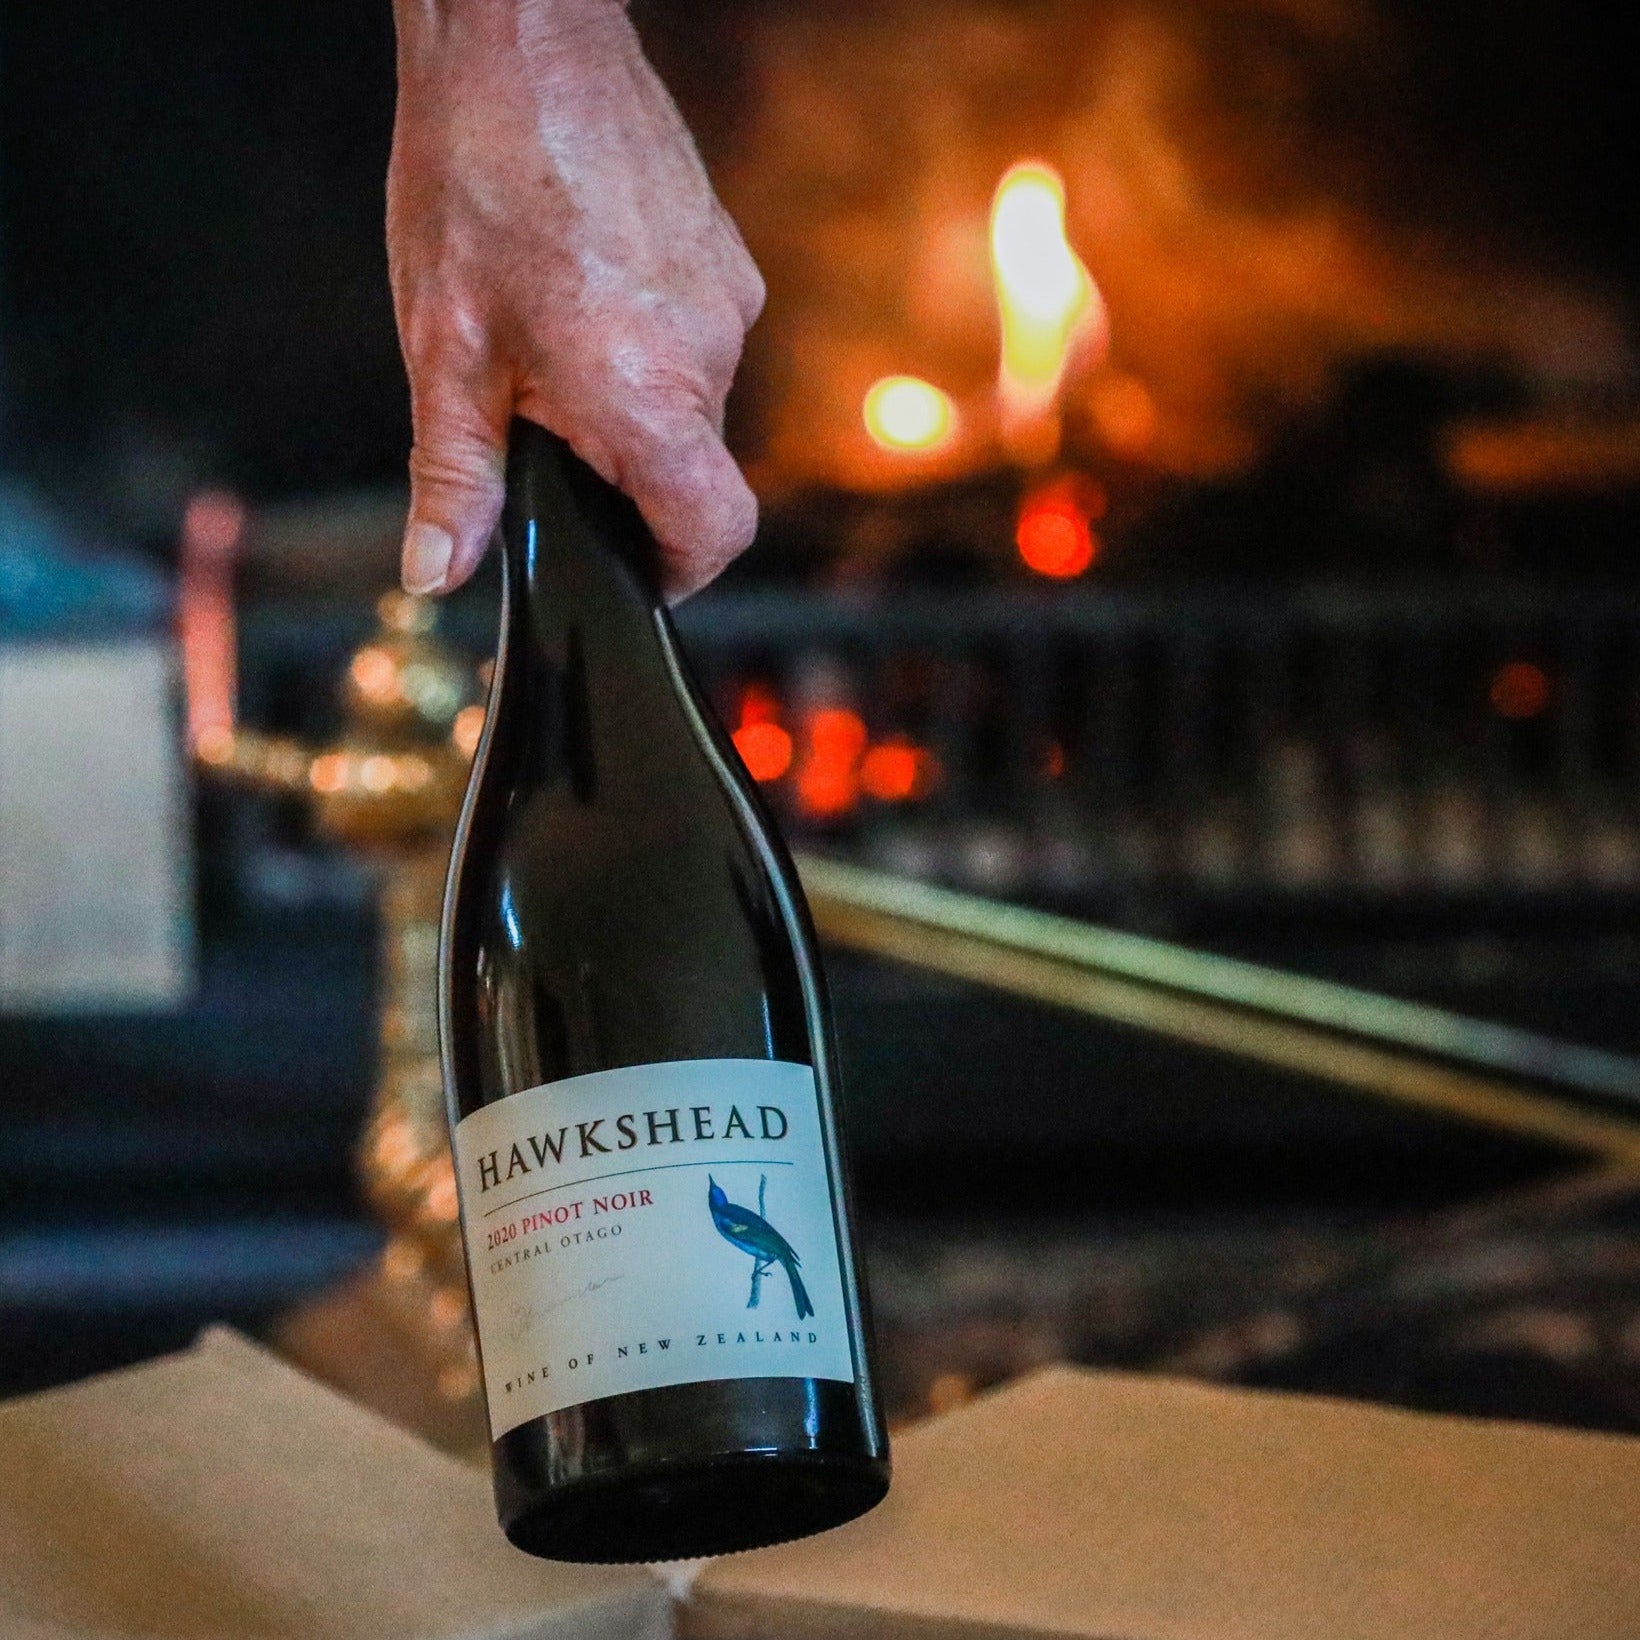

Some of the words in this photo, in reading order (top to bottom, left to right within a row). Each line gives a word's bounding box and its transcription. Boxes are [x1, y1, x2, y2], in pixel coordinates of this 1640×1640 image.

[477, 1104, 789, 1193] HAWKSHEAD
[487, 1222, 518, 1251] 2020
[521, 1202, 583, 1235] PINOT
[592, 1188, 655, 1216] NOIR
[490, 1242, 553, 1275] CENTRAL
[560, 1223, 623, 1250] OTAGO
[504, 1366, 551, 1395] WINE
[567, 1352, 597, 1370] OF
[617, 1337, 673, 1359] NEW
[696, 1330, 819, 1346] ZEALAND
